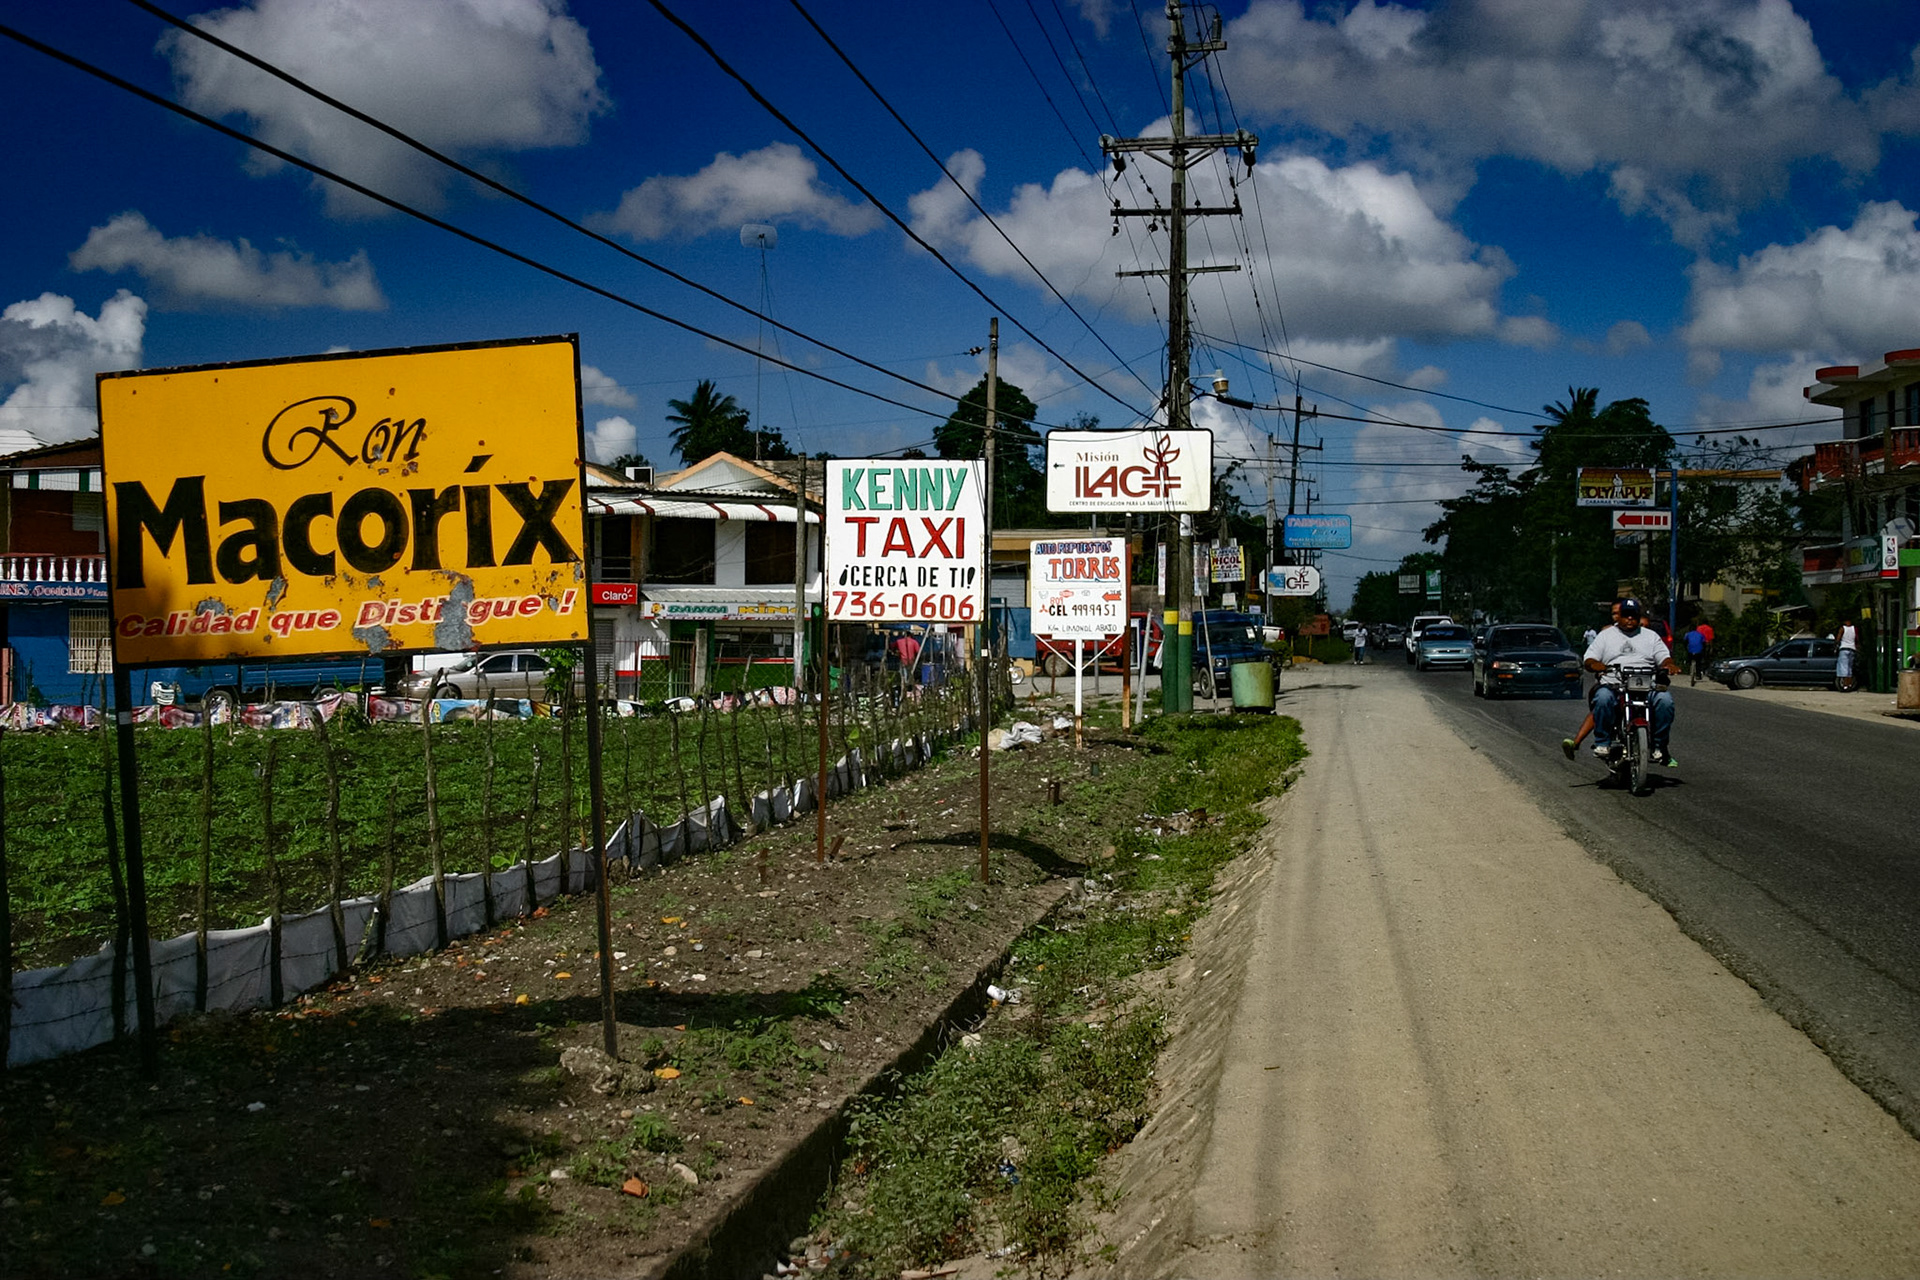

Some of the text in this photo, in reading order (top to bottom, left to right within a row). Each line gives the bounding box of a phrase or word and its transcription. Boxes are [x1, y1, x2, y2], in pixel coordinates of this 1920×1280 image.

[261, 395, 428, 471] Ron
[1076, 451, 1120, 463] Misión
[842, 467, 969, 511] KENNY
[113, 454, 583, 590] Macoríx
[844, 516, 966, 560] TAXI
[1034, 540, 1113, 555] AUTO REPUESTOS
[838, 564, 976, 590] ¡CERCA DE TI!
[1048, 556, 1120, 579] TORRES
[602, 590, 628, 601] Claro
[831, 590, 975, 621] 736-0606
[118, 607, 260, 639] Calidad
[268, 608, 342, 637] que
[355, 592, 542, 628] Distigue
[1048, 604, 1068, 617] CEL
